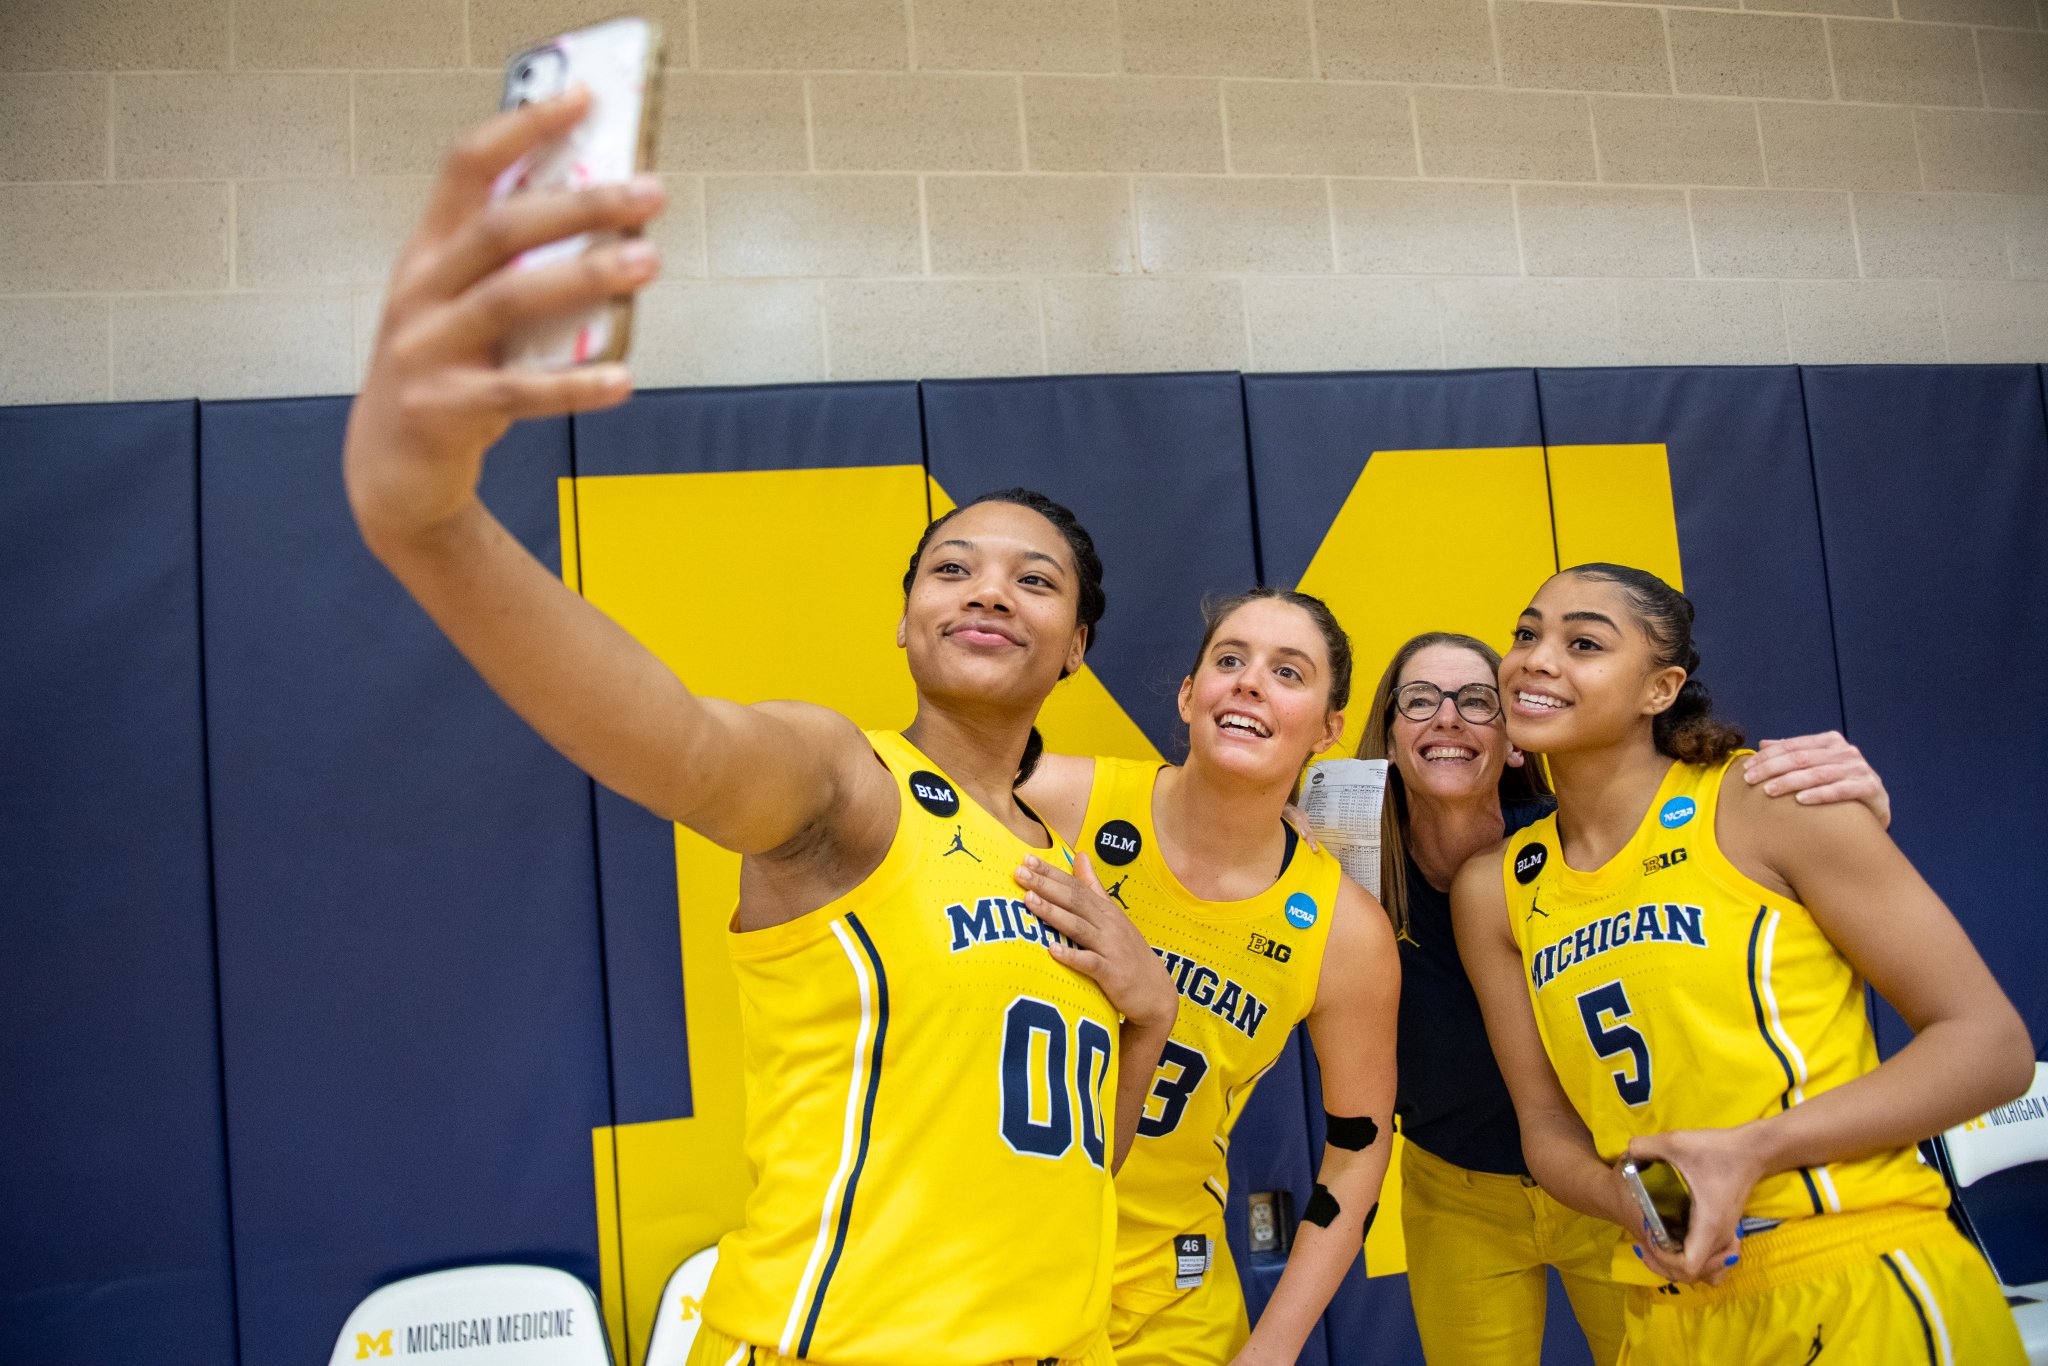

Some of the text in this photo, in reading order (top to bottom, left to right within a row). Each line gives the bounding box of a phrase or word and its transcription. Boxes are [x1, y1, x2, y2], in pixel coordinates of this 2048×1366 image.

[914, 783, 954, 802] BLM
[1663, 806, 1694, 822] NCAA
[1100, 832, 1137, 852] BLM
[1516, 852, 1543, 873] BLM
[944, 896, 1085, 954] MICH
[1287, 905, 1315, 924] NCAA
[1531, 903, 1709, 993] MICHIGAN
[1575, 978, 1652, 1108] 5
[999, 994, 1112, 1172] 00
[1136, 1037, 1210, 1138] 3
[1989, 1098, 2044, 1127] MICHIGAN
[1181, 1239, 1200, 1252] 46
[355, 1308, 575, 1360] M MICHIGAN MEDICINE
